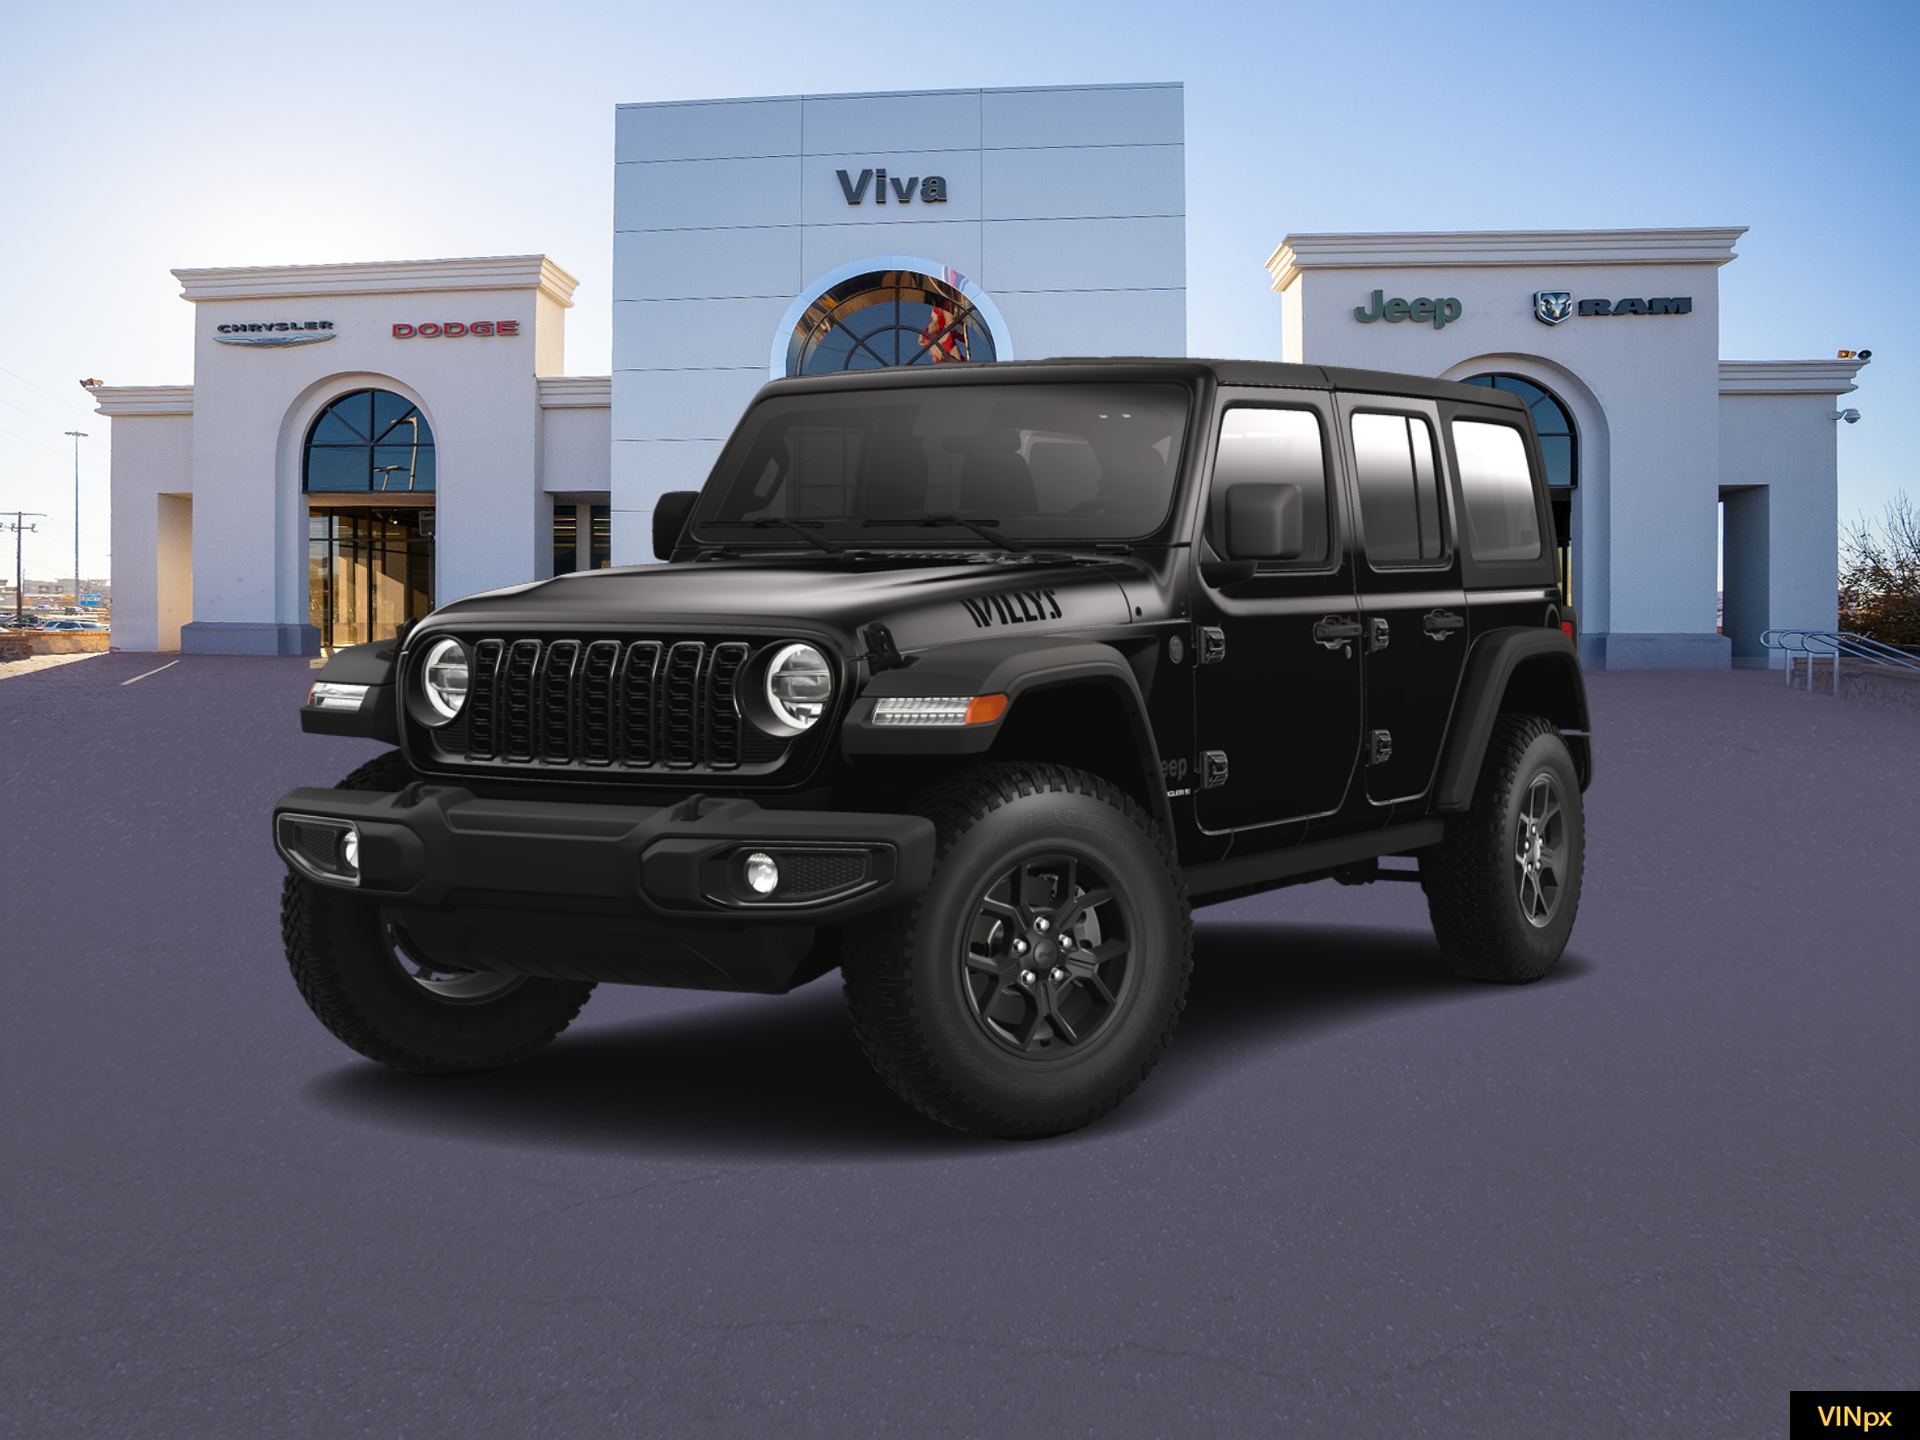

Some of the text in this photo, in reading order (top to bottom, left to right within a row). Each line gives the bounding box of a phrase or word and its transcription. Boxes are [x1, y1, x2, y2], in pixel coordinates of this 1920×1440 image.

[835, 168, 947, 205] Viva
[1354, 289, 1462, 329] Jeep
[1578, 297, 1692, 316] RAM
[217, 320, 334, 333] CHRYSLER
[392, 320, 520, 340] DODGE
[959, 589, 1062, 628] WILLYS
[1160, 758, 1188, 781] eep
